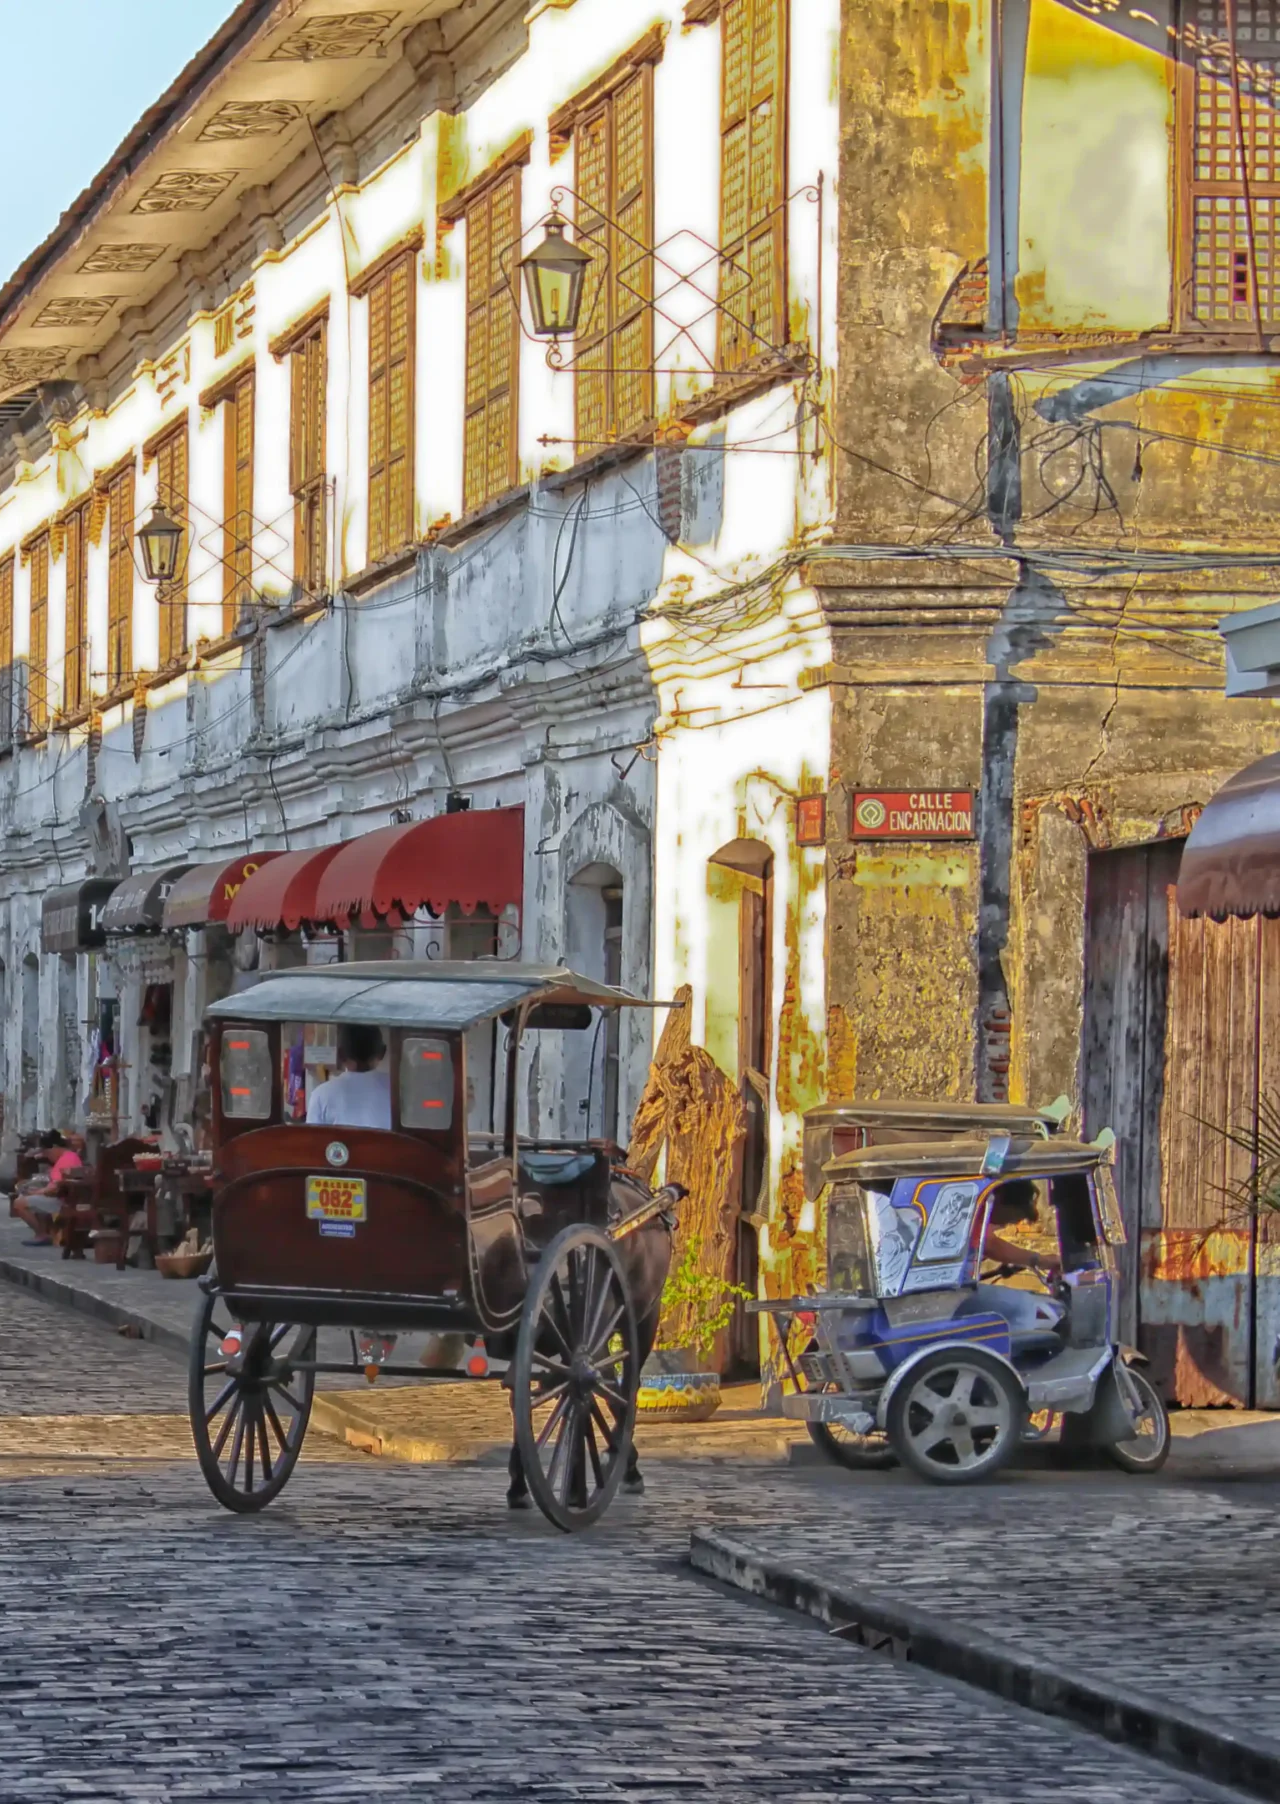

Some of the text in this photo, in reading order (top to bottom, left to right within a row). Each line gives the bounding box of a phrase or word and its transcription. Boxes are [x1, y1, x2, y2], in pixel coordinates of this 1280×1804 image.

[909, 793, 953, 809] CALLE
[889, 811, 971, 831] ENCARNACION
[319, 1189, 353, 1208] 082
